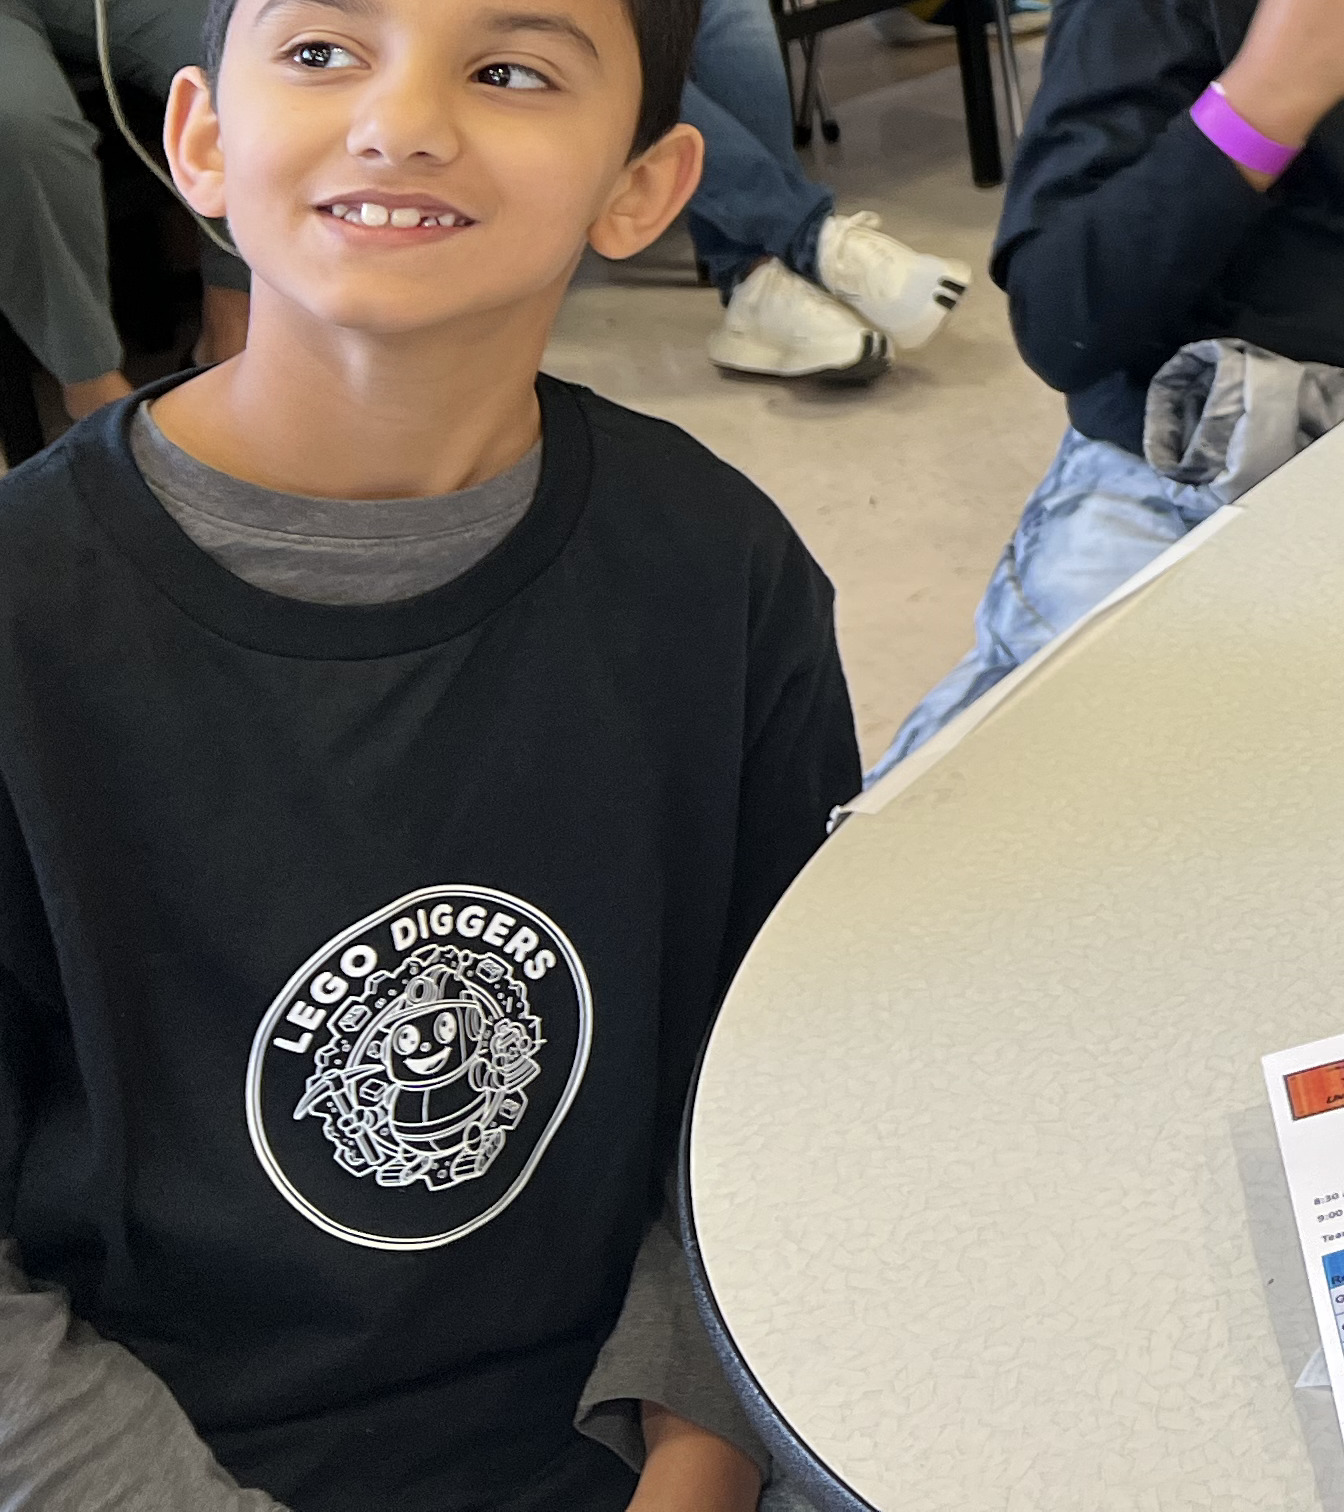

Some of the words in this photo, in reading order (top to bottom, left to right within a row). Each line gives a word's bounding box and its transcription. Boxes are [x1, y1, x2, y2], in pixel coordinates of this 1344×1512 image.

[273, 944, 378, 1053] LEGO
[390, 903, 557, 980] DIGGERS
[1313, 1191, 1340, 1206] 8:30
[1316, 1209, 1344, 1224] 9:00
